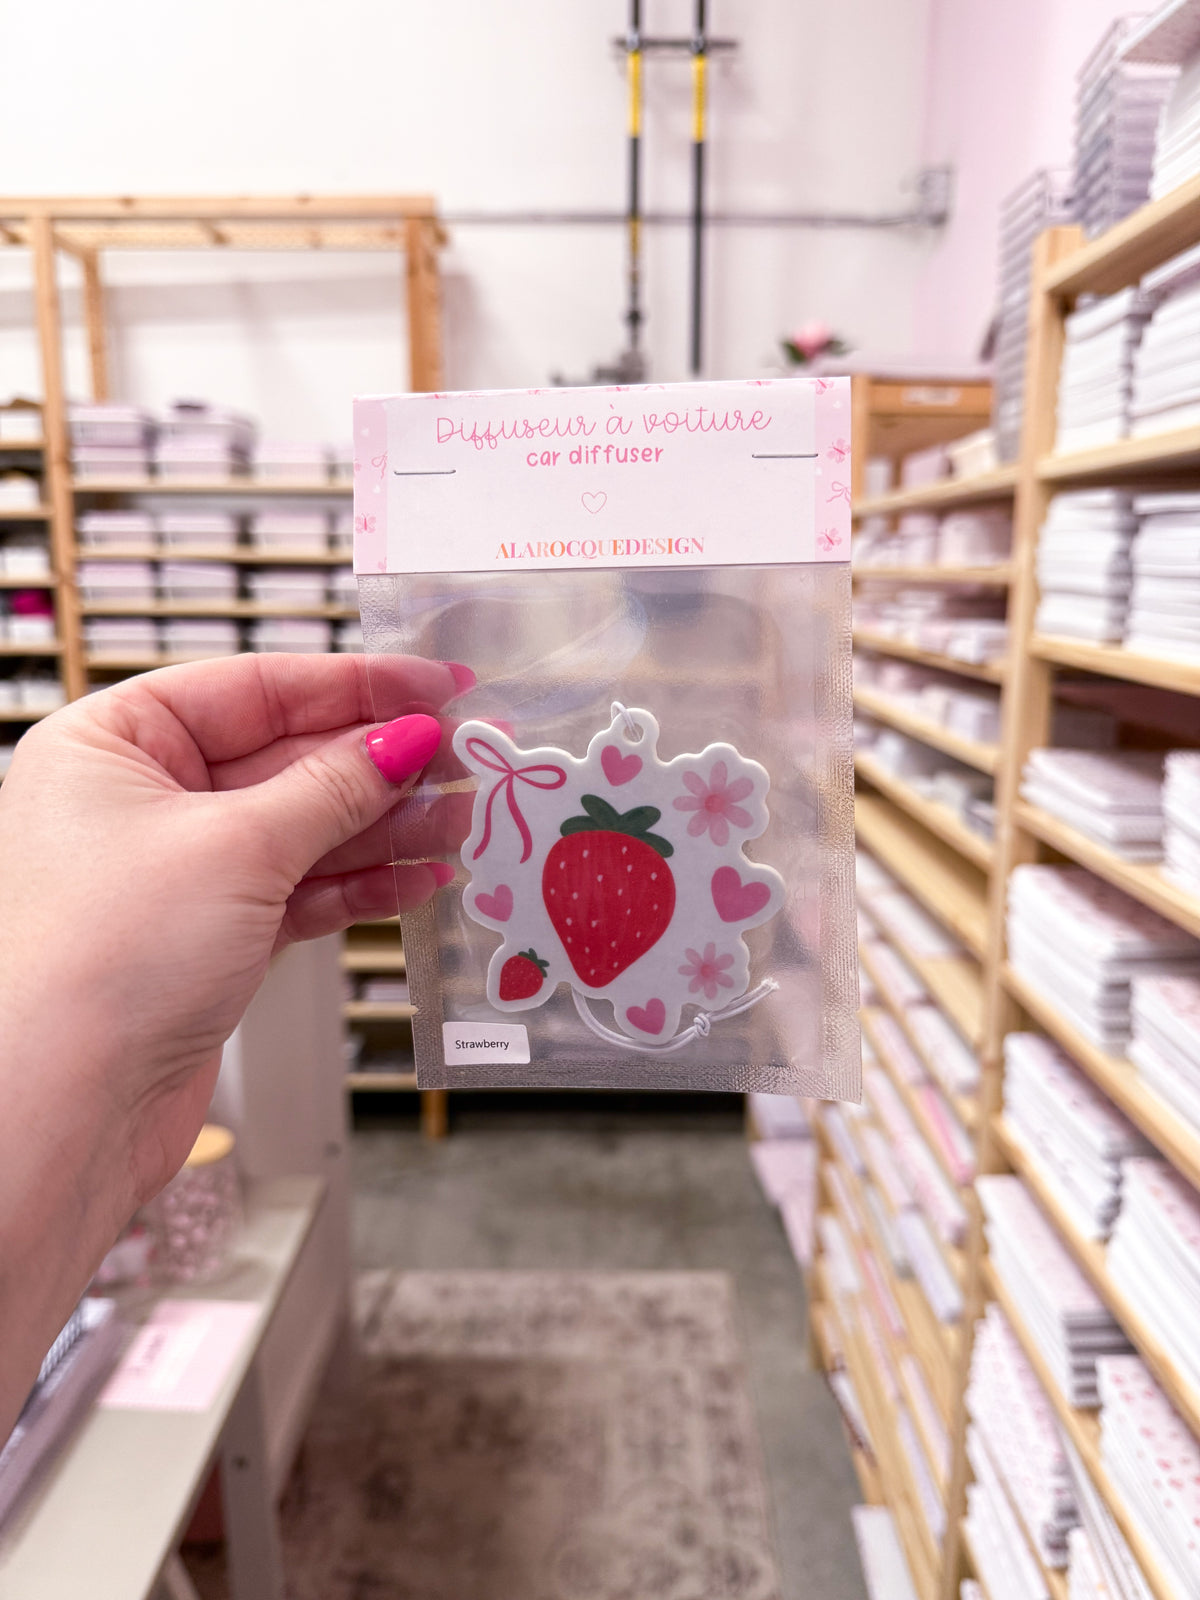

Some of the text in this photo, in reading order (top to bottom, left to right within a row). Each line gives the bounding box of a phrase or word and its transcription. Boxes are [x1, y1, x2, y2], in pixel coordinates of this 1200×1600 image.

[436, 404, 772, 450] Diffuseur à voiture
[526, 444, 664, 467] car diffuser
[495, 536, 705, 560] ALAROCQUEDESIGN
[455, 1039, 509, 1050] Strawberry
